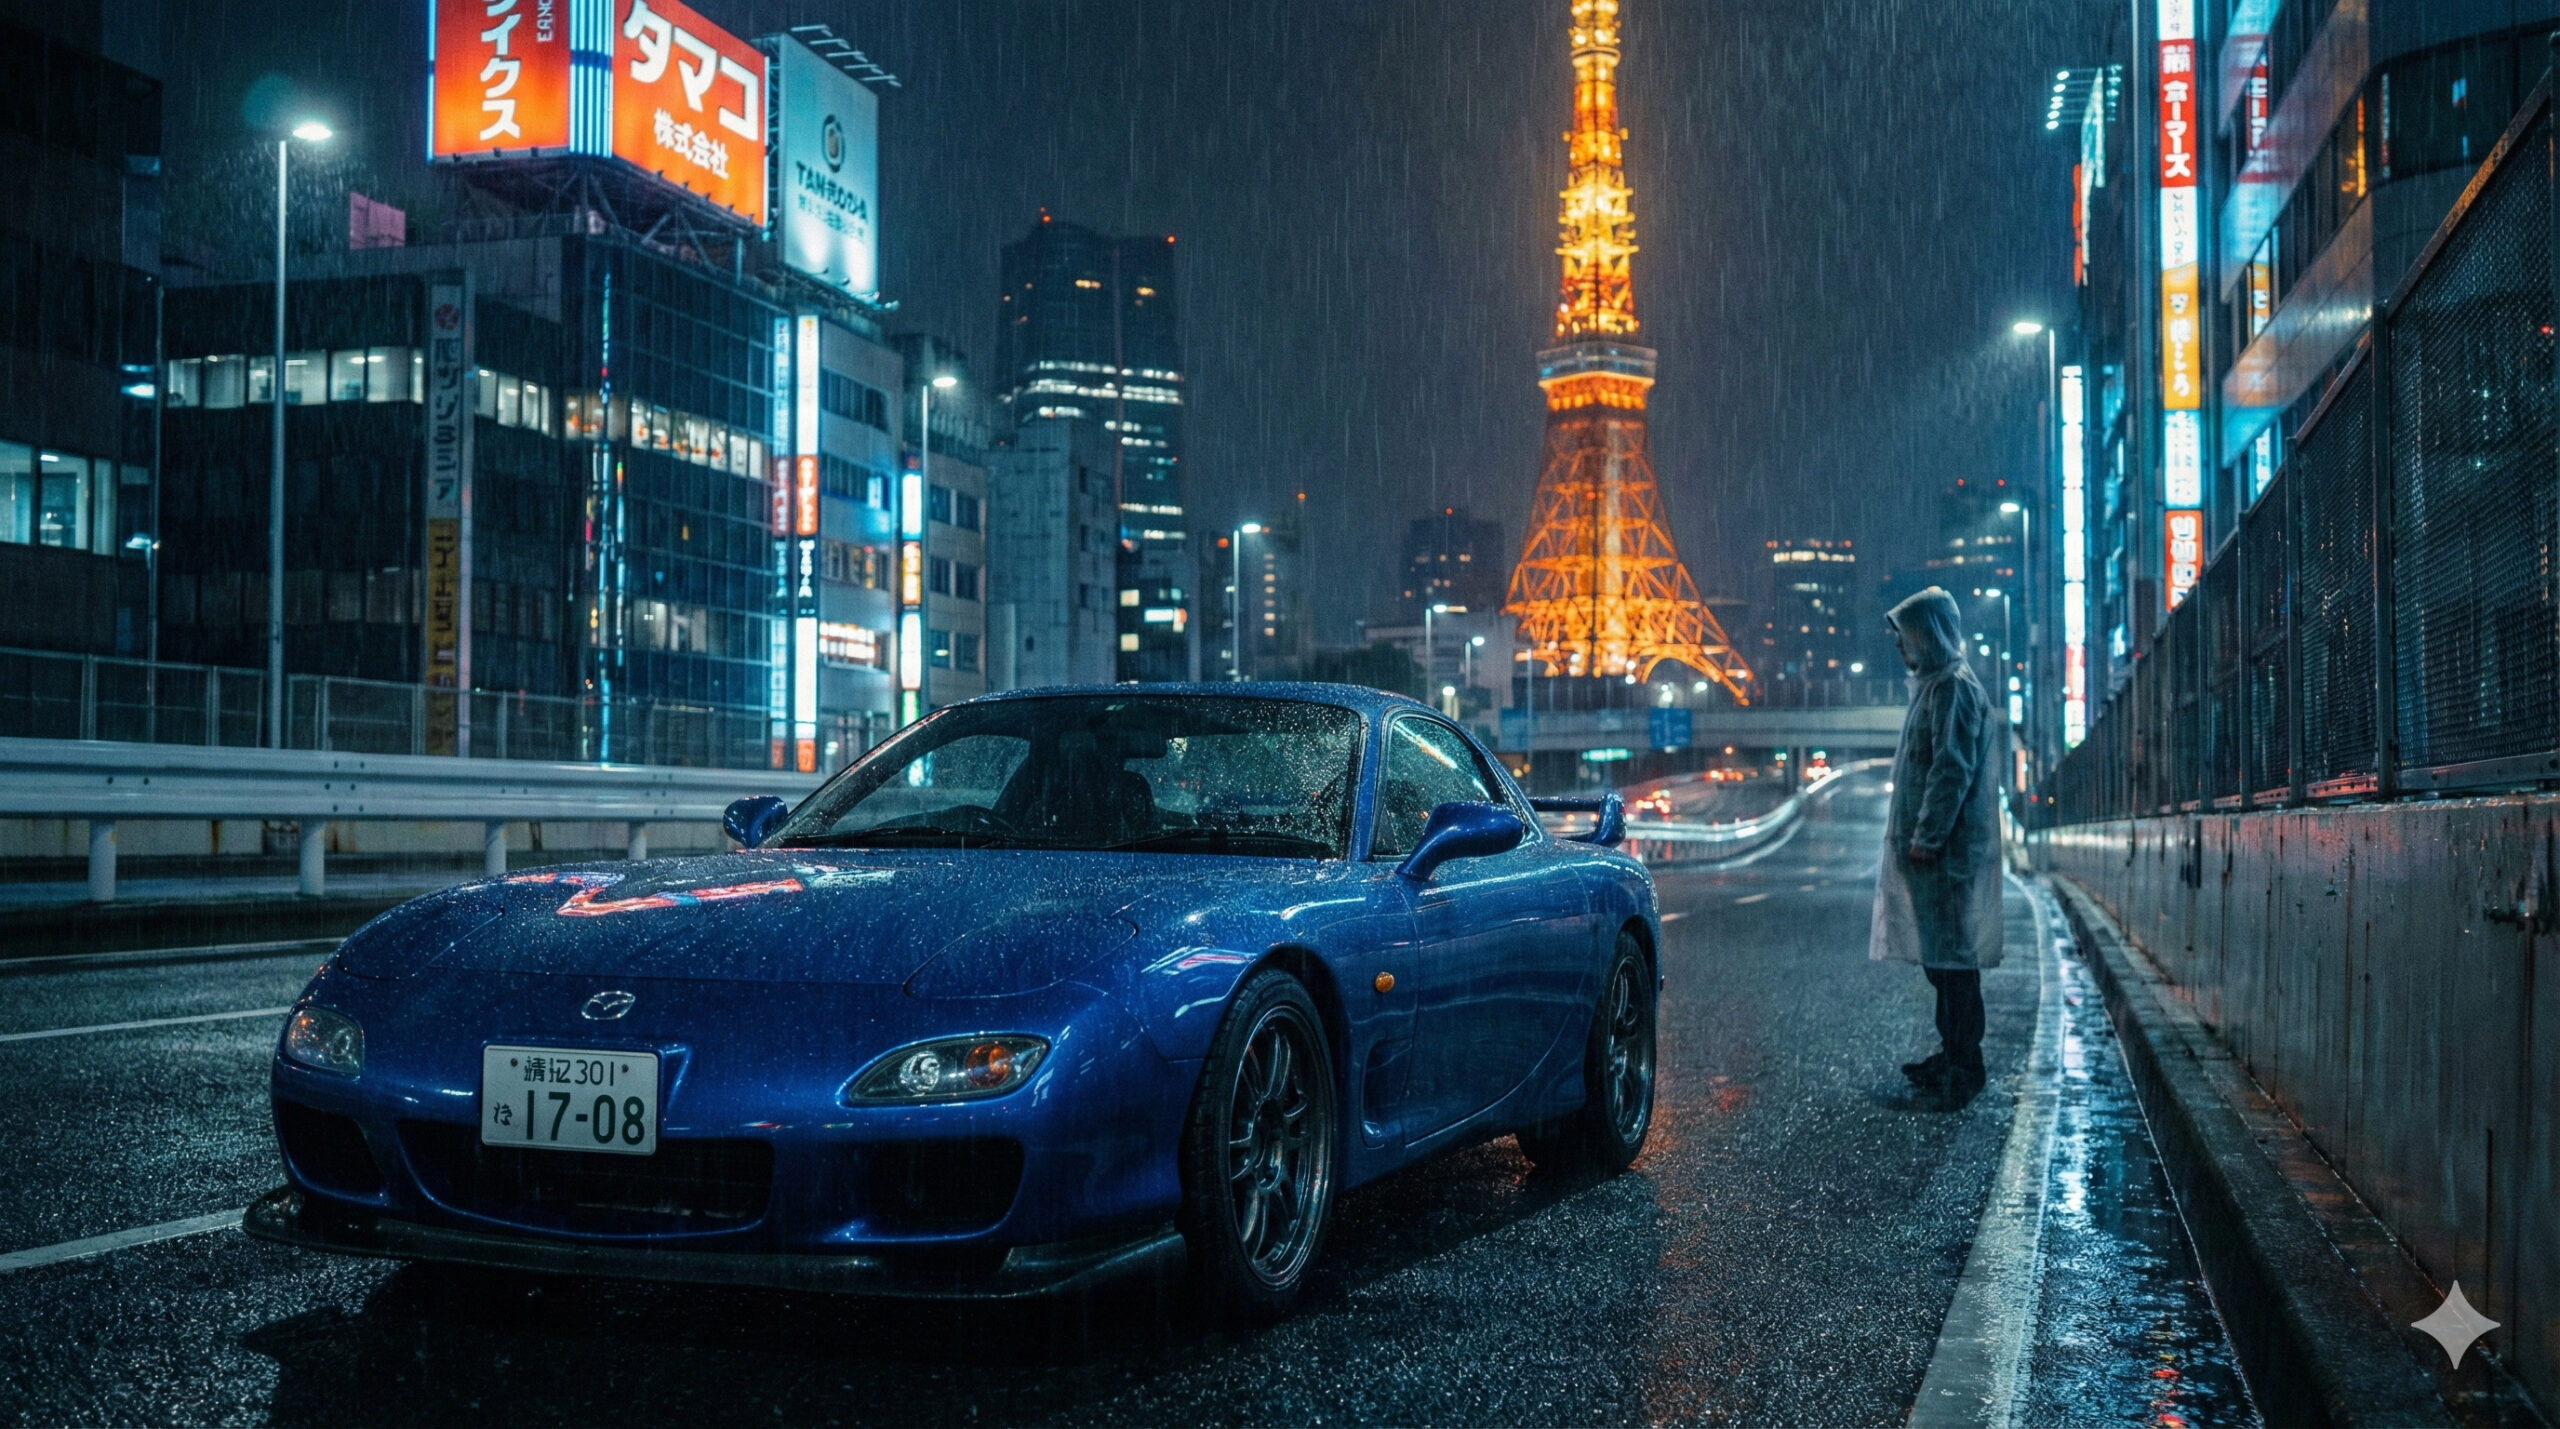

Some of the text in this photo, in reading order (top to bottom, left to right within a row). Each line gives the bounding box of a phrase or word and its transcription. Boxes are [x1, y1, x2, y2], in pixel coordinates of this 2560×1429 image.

[623, 0, 759, 142] タマコ
[653, 106, 729, 180] 株式会社
[525, 1089, 645, 1146] 17-08
